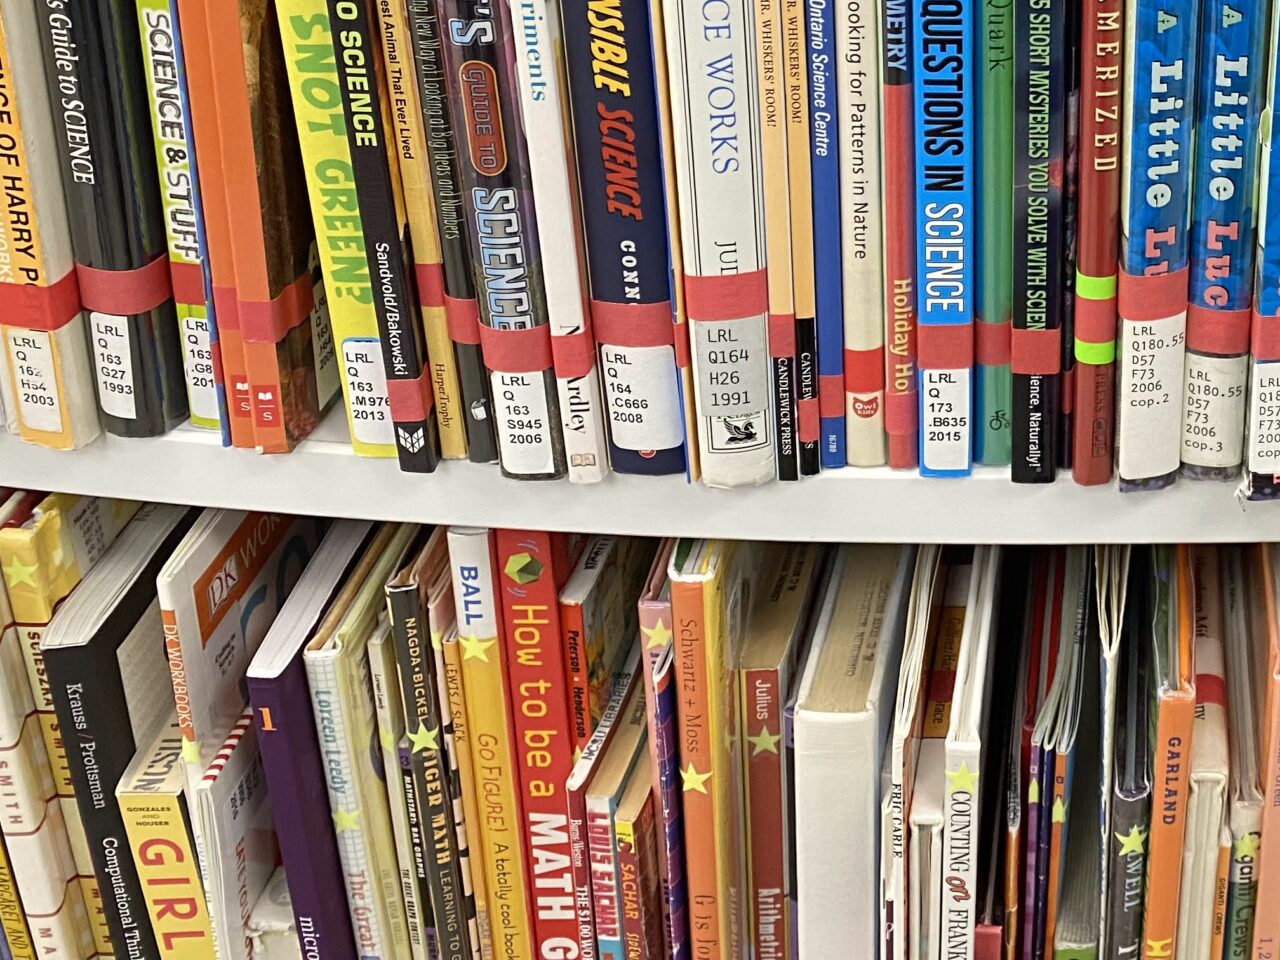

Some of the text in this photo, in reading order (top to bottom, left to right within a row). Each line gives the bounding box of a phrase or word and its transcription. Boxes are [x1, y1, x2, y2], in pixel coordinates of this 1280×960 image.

[49, 11, 78, 68] Guide
[289, 14, 348, 138] SNOT
[383, 20, 399, 65] Animal
[59, 70, 76, 94] to
[340, 30, 378, 147] SCIENCE
[391, 66, 403, 95] That
[394, 97, 407, 125] Ever
[705, 53, 741, 175] WORKS
[850, 68, 867, 96] for
[61, 93, 95, 186] SCIENCE
[145, 13, 200, 259] SCIENCE & STUFF
[399, 127, 414, 160] Lived
[597, 102, 643, 221] SCIENCE
[850, 103, 865, 179] Patterns
[1146, 59, 1183, 208] Little
[1209, 55, 1249, 201] Little
[853, 182, 865, 197] in
[924, 166, 964, 192] IN
[315, 159, 372, 305] GREEN?
[472, 187, 533, 331] SCIENCE
[853, 203, 866, 260] Nature
[924, 203, 965, 314] SCIENCE
[96, 324, 124, 337] LRL
[99, 338, 108, 349] Q
[376, 242, 409, 376] Sandvold/Bakowski
[101, 353, 121, 365] 163
[101, 367, 126, 380] G27
[103, 381, 133, 394] 1993
[459, 565, 484, 625] BALL
[163, 624, 193, 729] DK WORKBOOKS
[756, 679, 772, 720] Julius
[66, 683, 106, 810] Krauss Prottsman
[511, 604, 575, 922] How to be a MATH
[1163, 736, 1181, 826] GARLAND
[138, 837, 206, 951] GIRL
